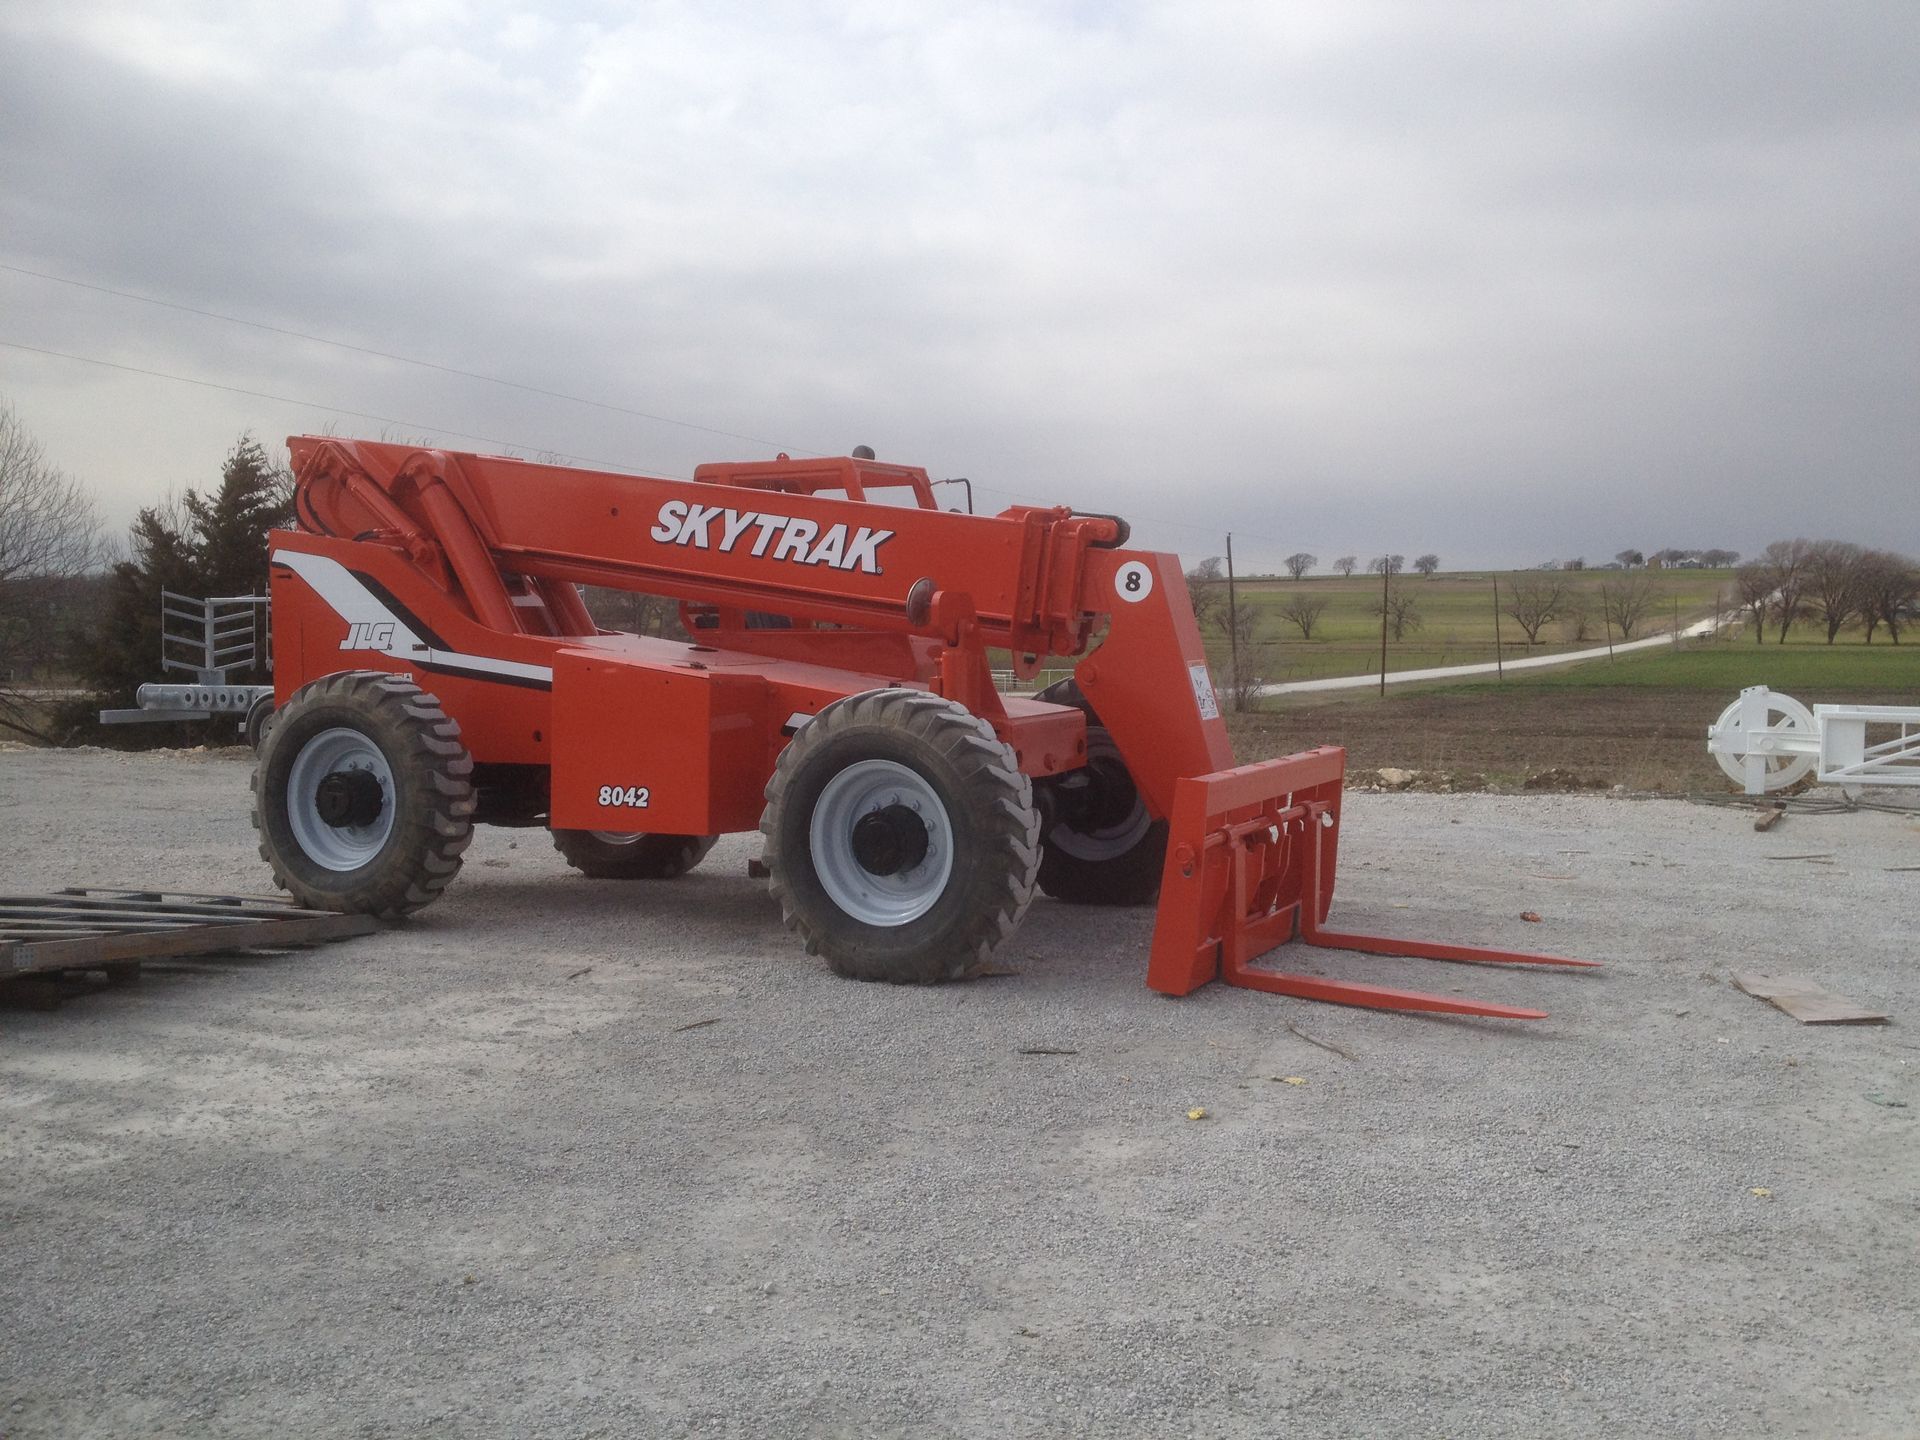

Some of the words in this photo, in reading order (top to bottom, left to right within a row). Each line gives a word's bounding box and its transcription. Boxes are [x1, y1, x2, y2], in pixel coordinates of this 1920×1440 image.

[650, 500, 894, 575] SKYTRAK
[1125, 571, 1141, 592] 8
[339, 622, 395, 650] JLG
[598, 785, 649, 808] 8042
